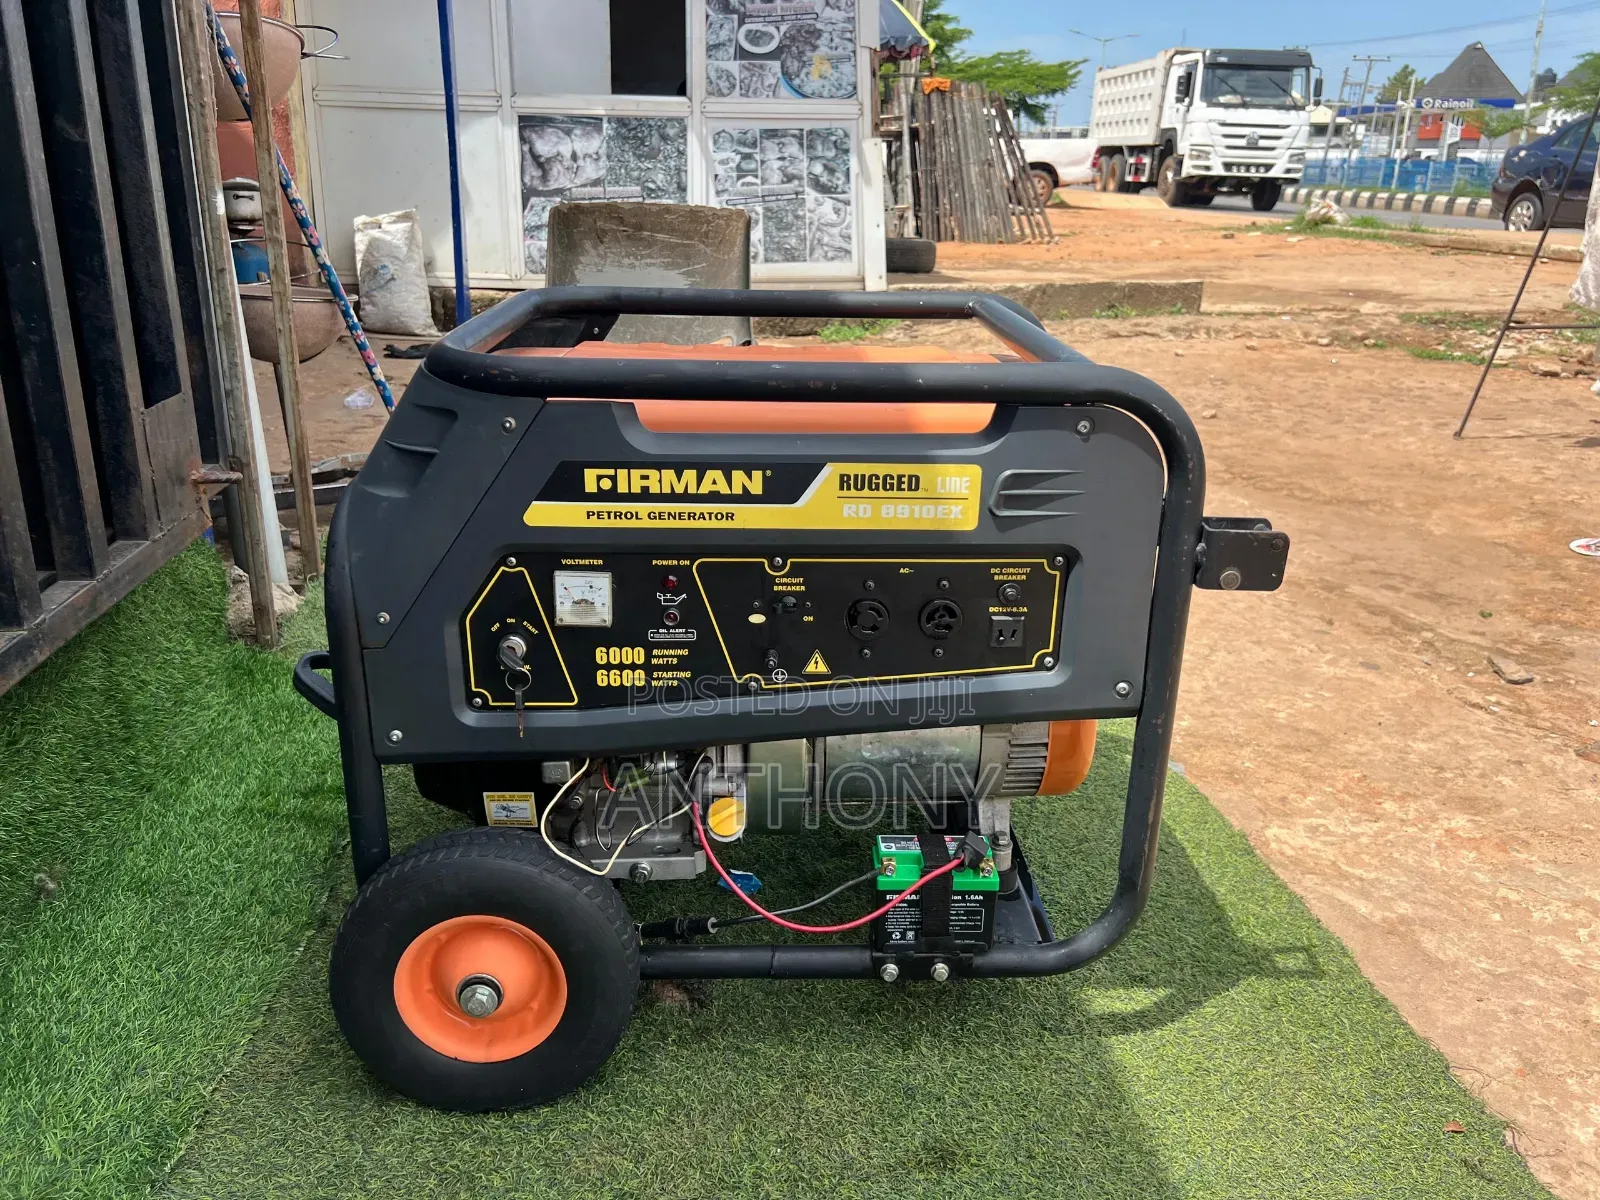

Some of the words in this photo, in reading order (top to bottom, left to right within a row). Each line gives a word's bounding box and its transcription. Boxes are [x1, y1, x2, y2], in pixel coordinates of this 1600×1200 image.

[1434, 98, 1474, 109] Rainoil
[584, 468, 763, 494] FIRMAN
[838, 473, 920, 492] RUGGED
[937, 476, 970, 494] LINE
[586, 510, 643, 521] PETROL
[647, 510, 735, 521] GENERATOR
[843, 503, 872, 518] RD
[491, 622, 500, 632] OFF
[522, 620, 539, 635] START
[595, 646, 645, 665] 6000
[596, 669, 646, 687] 6600
